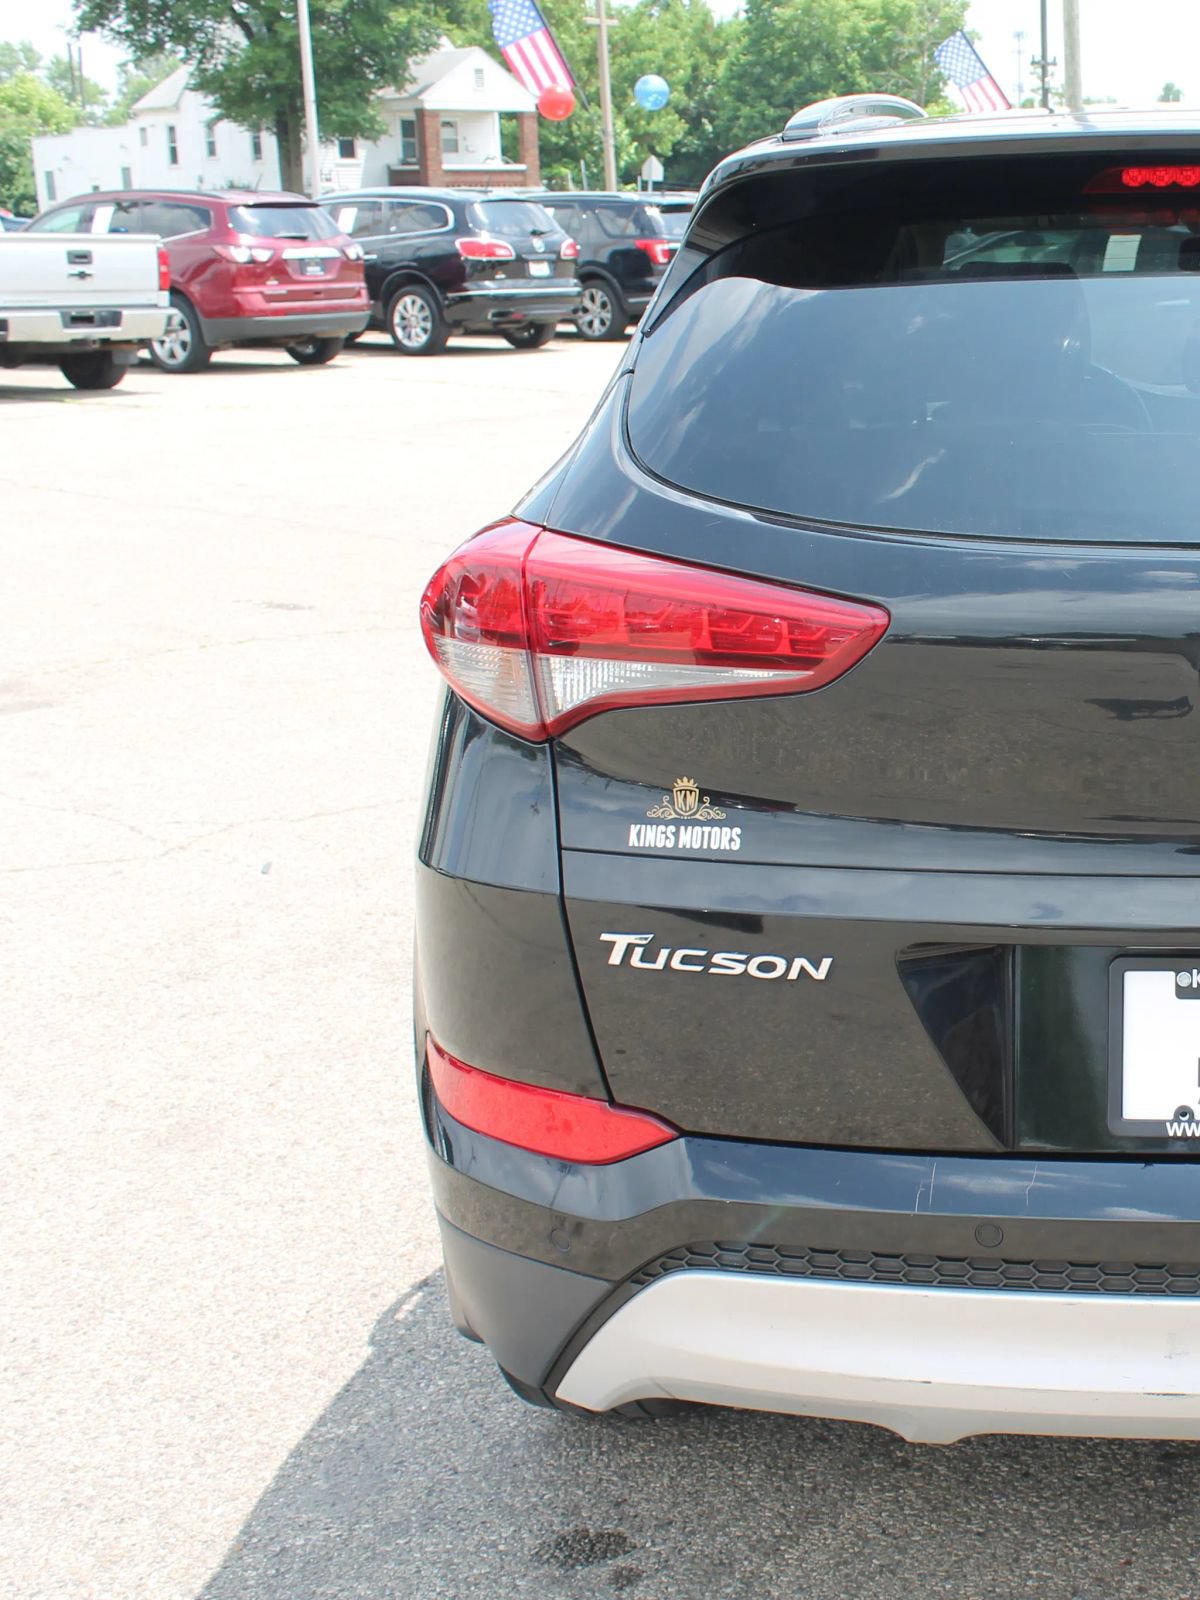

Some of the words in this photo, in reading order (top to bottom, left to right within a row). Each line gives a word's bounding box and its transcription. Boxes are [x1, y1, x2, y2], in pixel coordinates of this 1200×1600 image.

[676, 790, 696, 811] KM
[628, 824, 676, 848] KINGS
[678, 826, 741, 850] MOTORS
